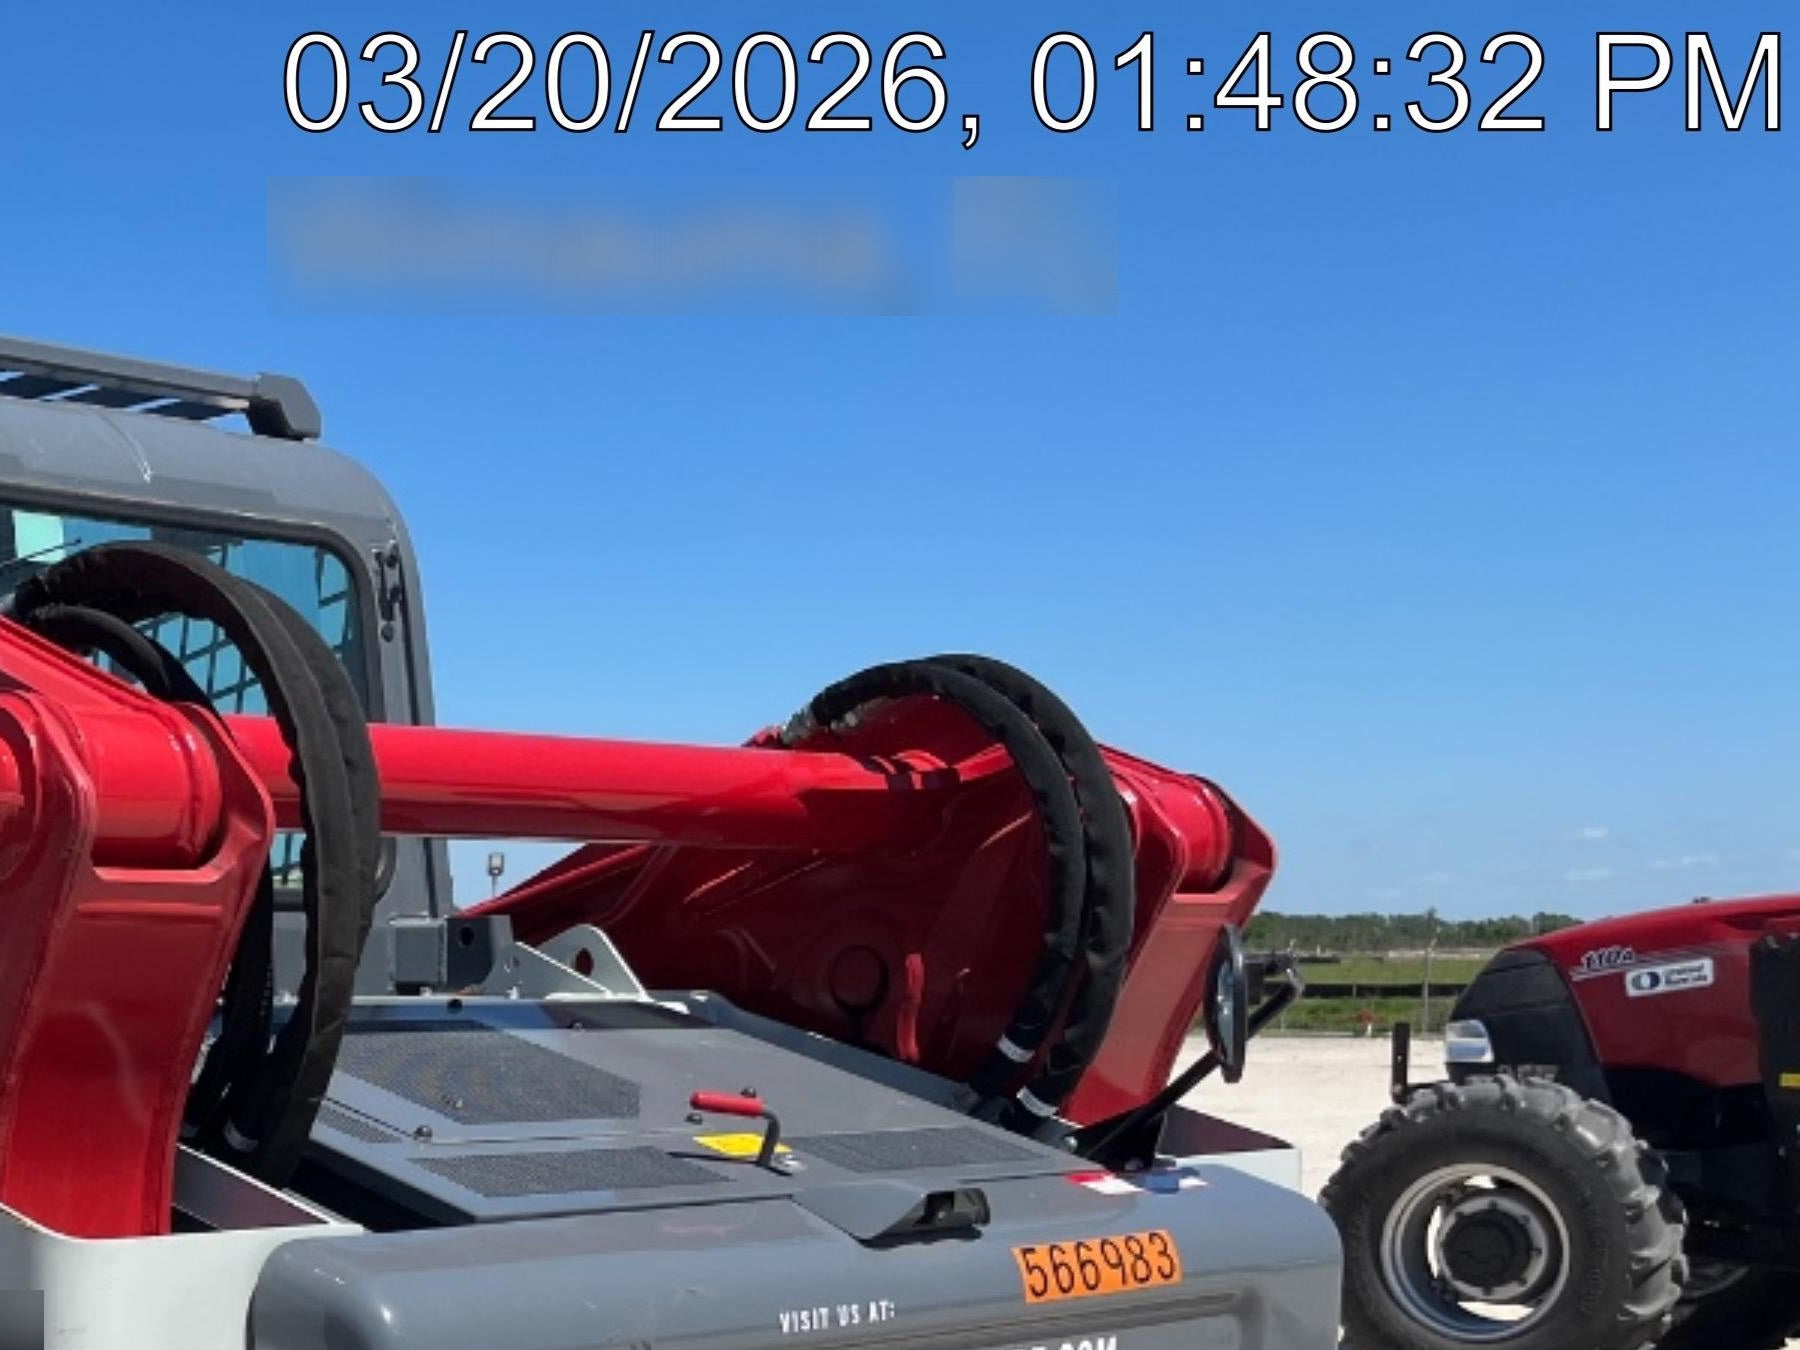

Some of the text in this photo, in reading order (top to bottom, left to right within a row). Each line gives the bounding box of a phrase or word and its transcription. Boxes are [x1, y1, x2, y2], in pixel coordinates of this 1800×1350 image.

[1021, 1231, 1177, 1297] 566983
[779, 1300, 896, 1334] VISIT US AT:
